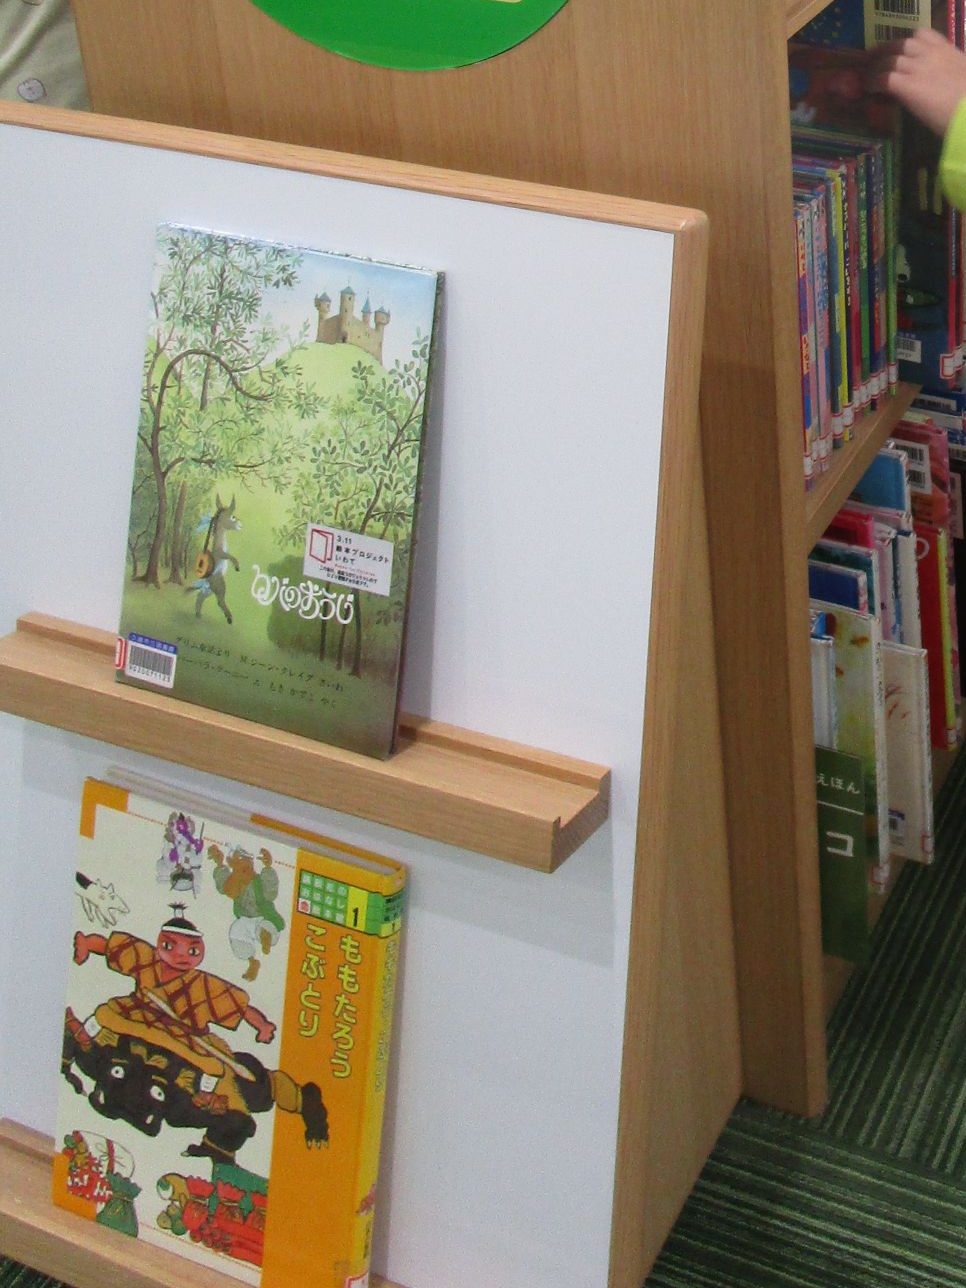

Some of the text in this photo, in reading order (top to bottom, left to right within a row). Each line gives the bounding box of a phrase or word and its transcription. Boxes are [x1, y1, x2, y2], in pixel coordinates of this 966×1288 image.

[336, 535, 352, 545] 3.11
[335, 554, 356, 565] いわて
[816, 772, 861, 795] えほん
[825, 830, 855, 858] コ
[352, 906, 360, 928] 1
[297, 922, 328, 1038] こぶとり
[330, 934, 363, 1080] ももたろう
